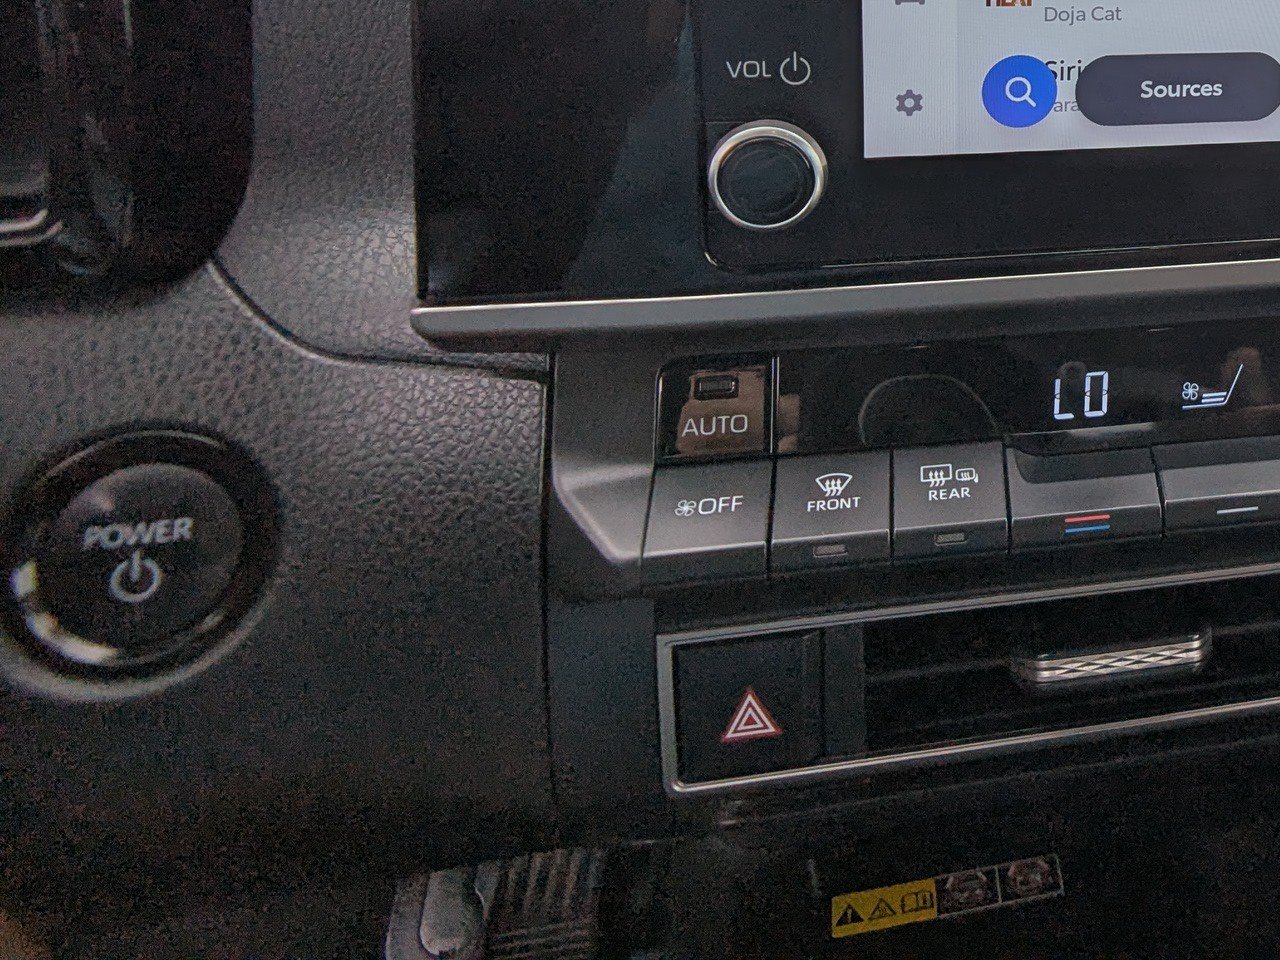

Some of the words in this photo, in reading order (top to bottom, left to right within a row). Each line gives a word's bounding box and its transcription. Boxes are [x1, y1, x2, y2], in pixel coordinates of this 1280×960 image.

[1044, 6, 1087, 27] Doja
[1091, 6, 1123, 23] Cat
[726, 60, 772, 78] VOL
[1140, 79, 1223, 99] Sources
[681, 413, 749, 438] AUTO
[927, 485, 972, 501] REAR
[697, 494, 744, 516] OFF
[806, 495, 861, 512] FRONT
[83, 517, 195, 551] POWER
